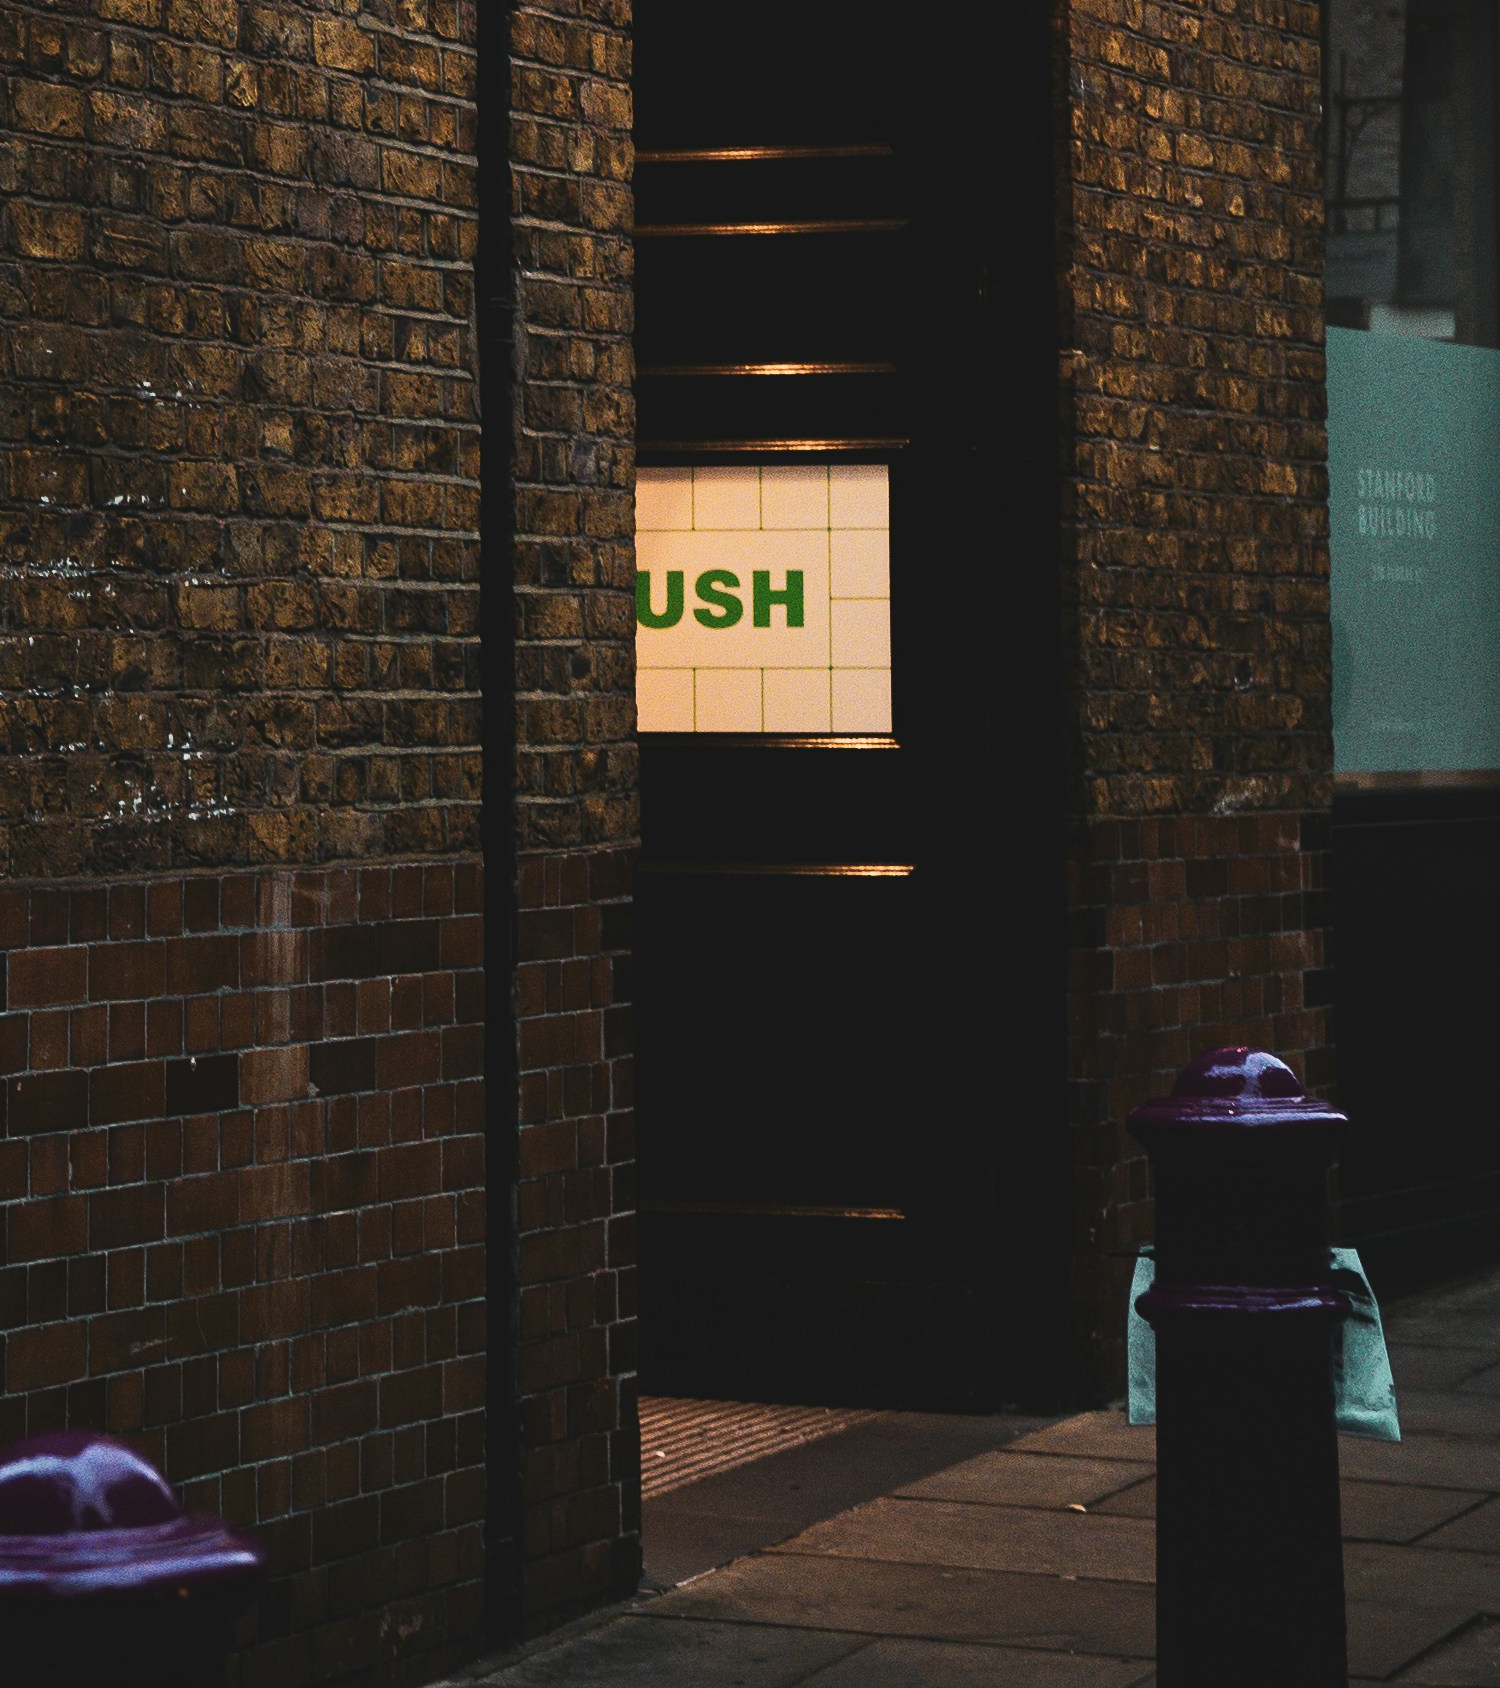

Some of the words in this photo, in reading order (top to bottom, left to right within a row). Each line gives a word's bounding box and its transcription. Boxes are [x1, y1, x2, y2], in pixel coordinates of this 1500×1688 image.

[1357, 468, 1436, 503] STANFORD
[1358, 503, 1437, 540] BUILDING
[635, 569, 805, 629] USH
